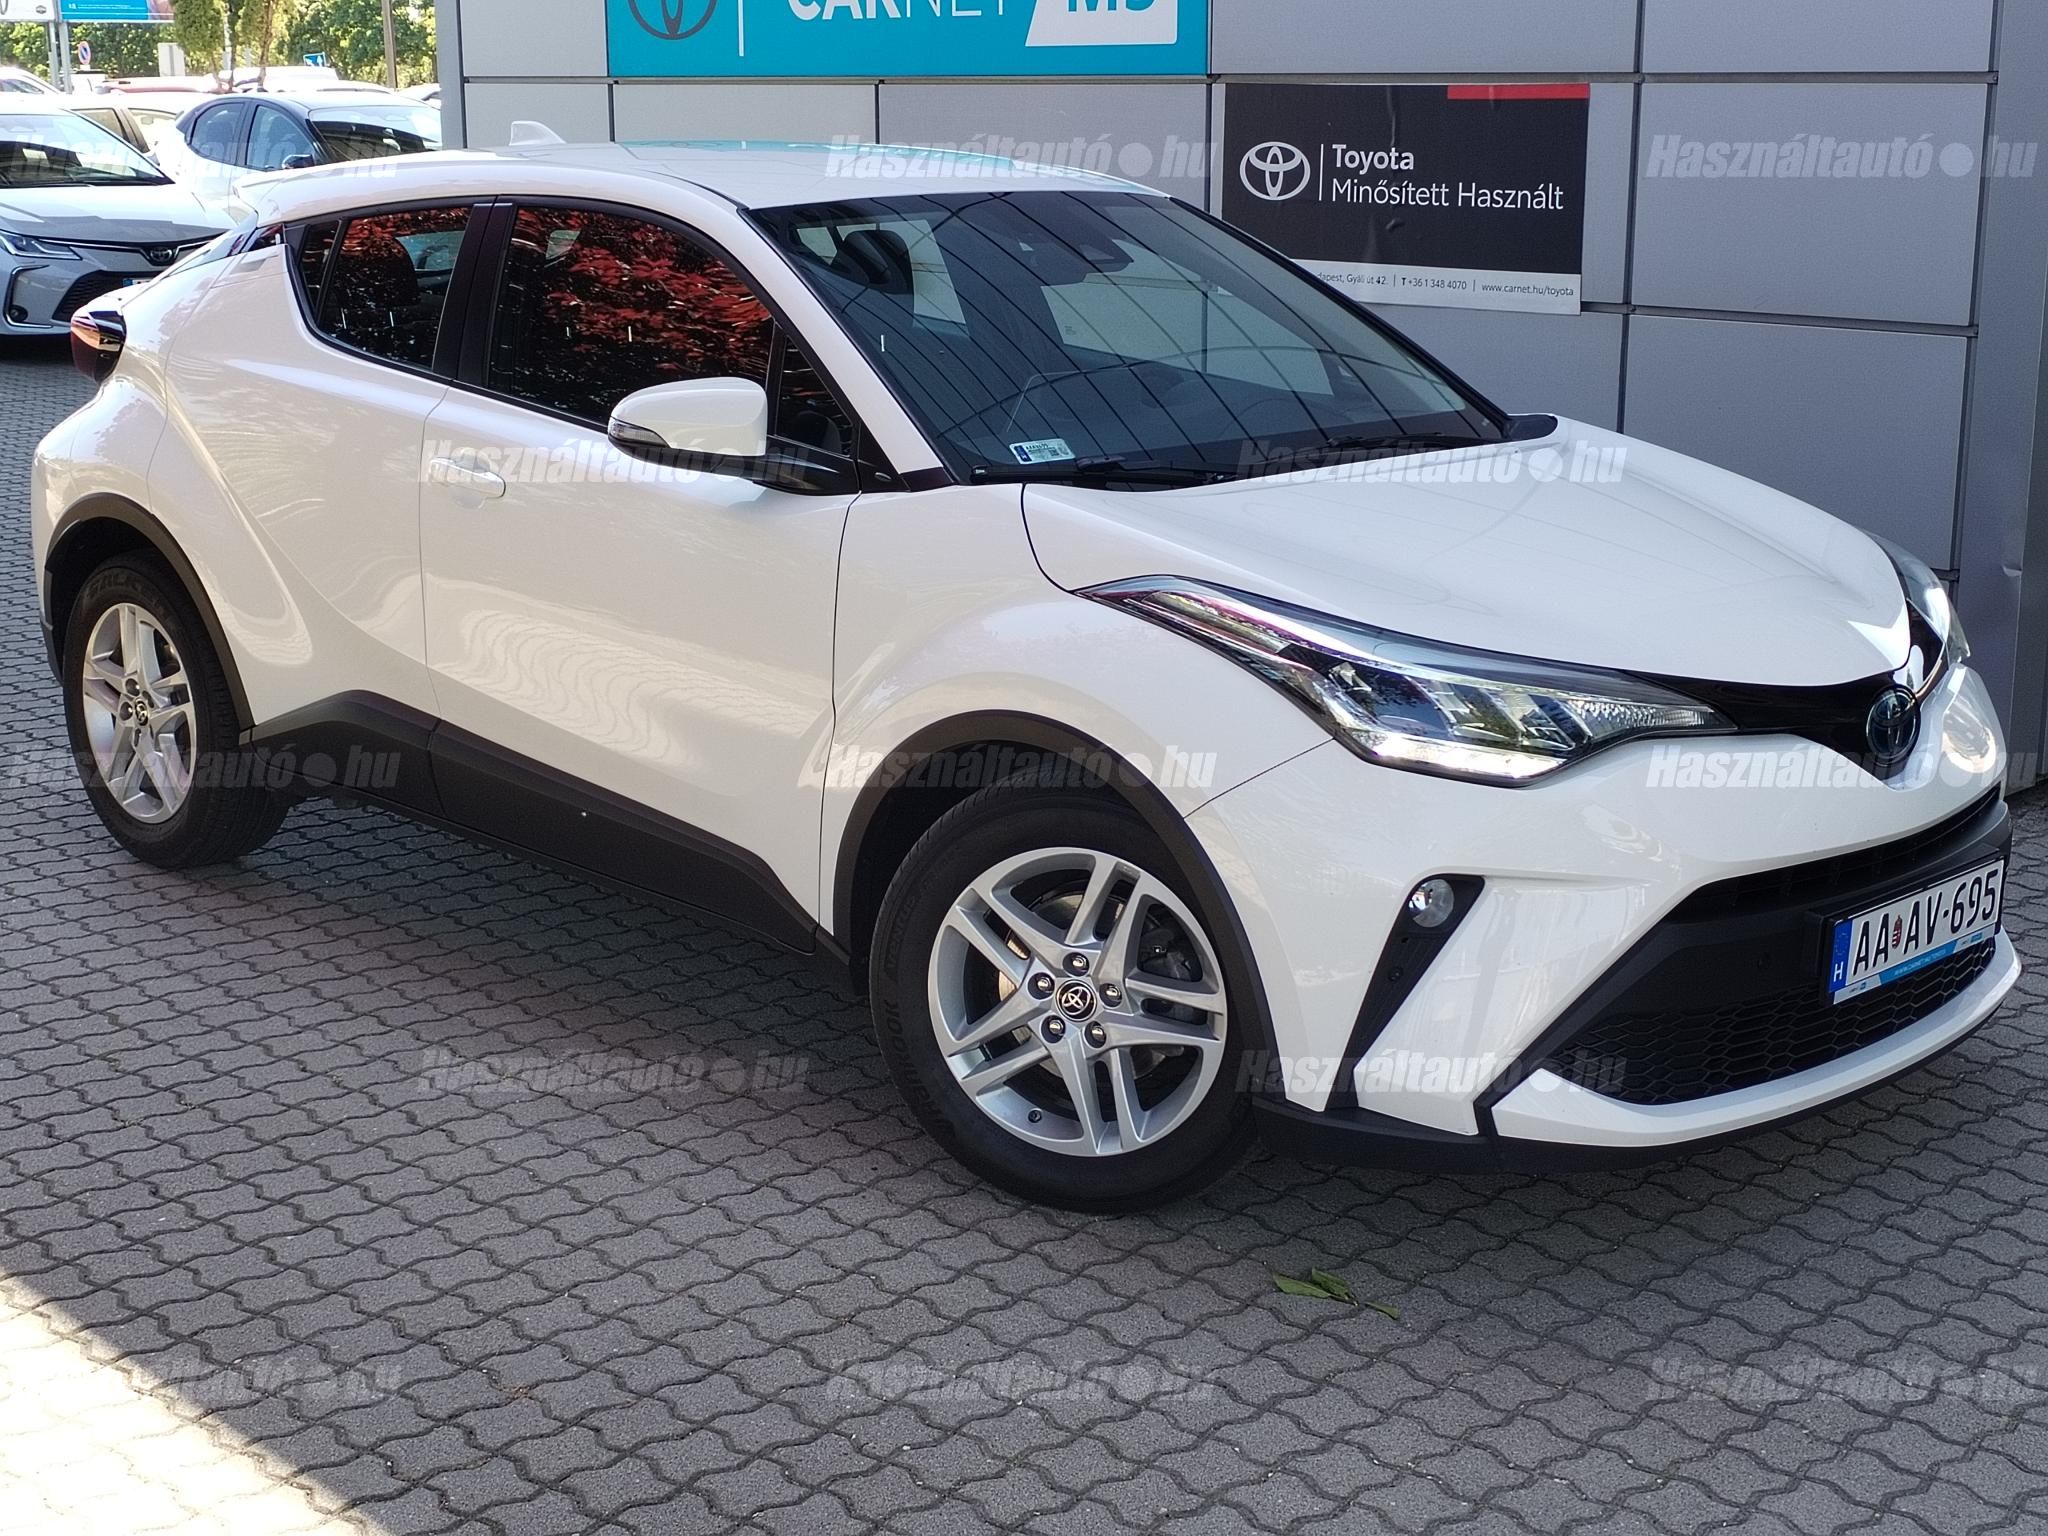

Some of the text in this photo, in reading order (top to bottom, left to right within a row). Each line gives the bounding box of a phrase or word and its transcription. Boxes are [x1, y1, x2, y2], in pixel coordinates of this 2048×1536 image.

[1332, 144, 1414, 175] Toyota
[1332, 178, 1563, 210] Minősített Használt
[1481, 284, 1574, 297] www.carnet.hu/toyota
[1833, 961, 1844, 983] H
